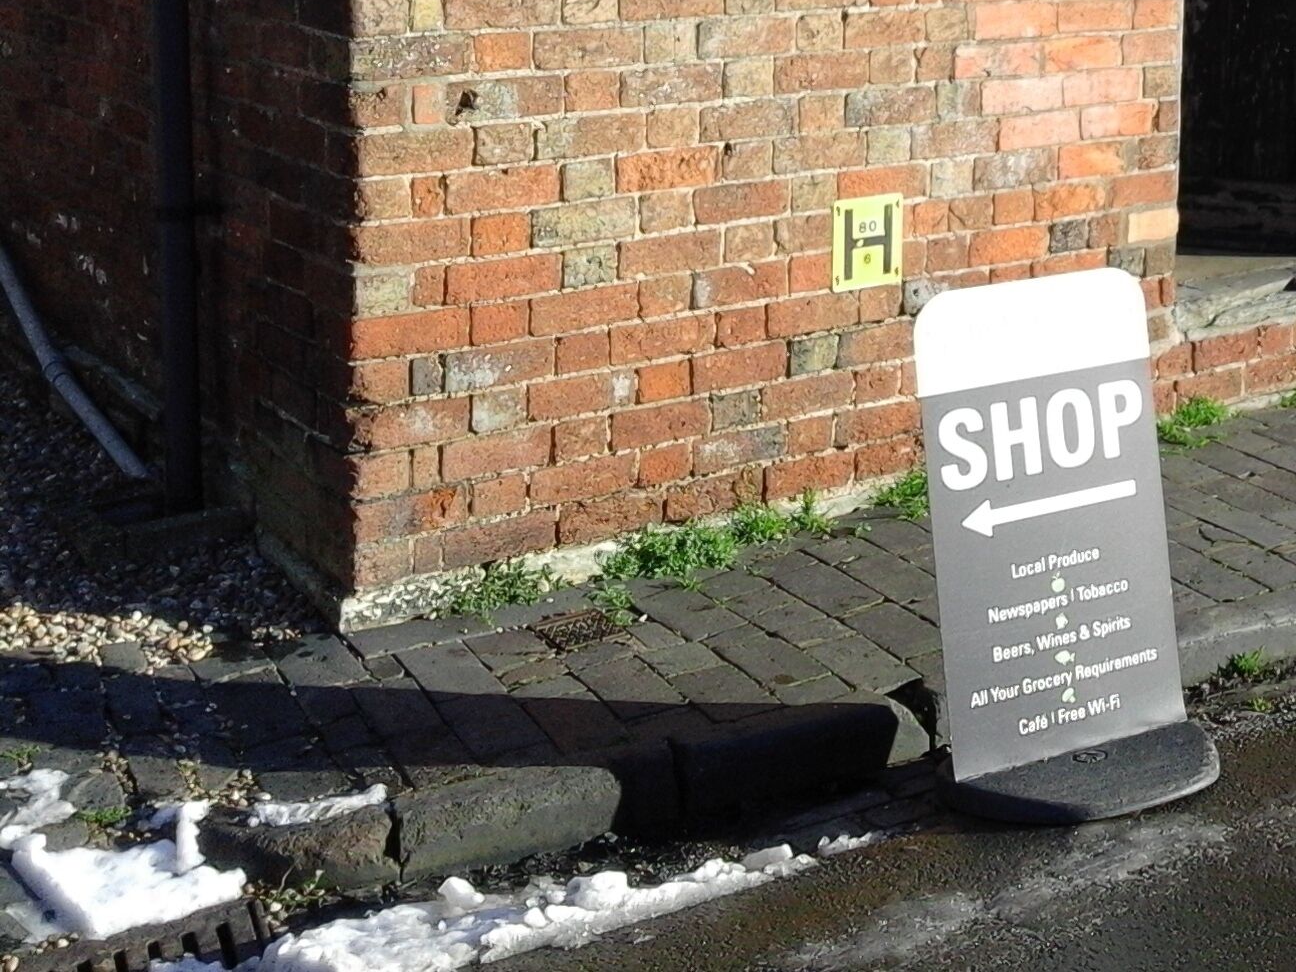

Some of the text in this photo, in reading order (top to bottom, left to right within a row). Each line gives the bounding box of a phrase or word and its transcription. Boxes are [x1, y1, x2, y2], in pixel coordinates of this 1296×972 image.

[844, 204, 893, 281] H
[938, 379, 1142, 491] SHOP
[1011, 547, 1100, 579] Local Produce
[988, 579, 1129, 623] Newspapers Tobacco
[993, 615, 1131, 663] Beers, Wines & Spirits
[970, 647, 1158, 709] All Your Grocery Requirements
[1019, 693, 1121, 736] Café Free Wi-Fi
